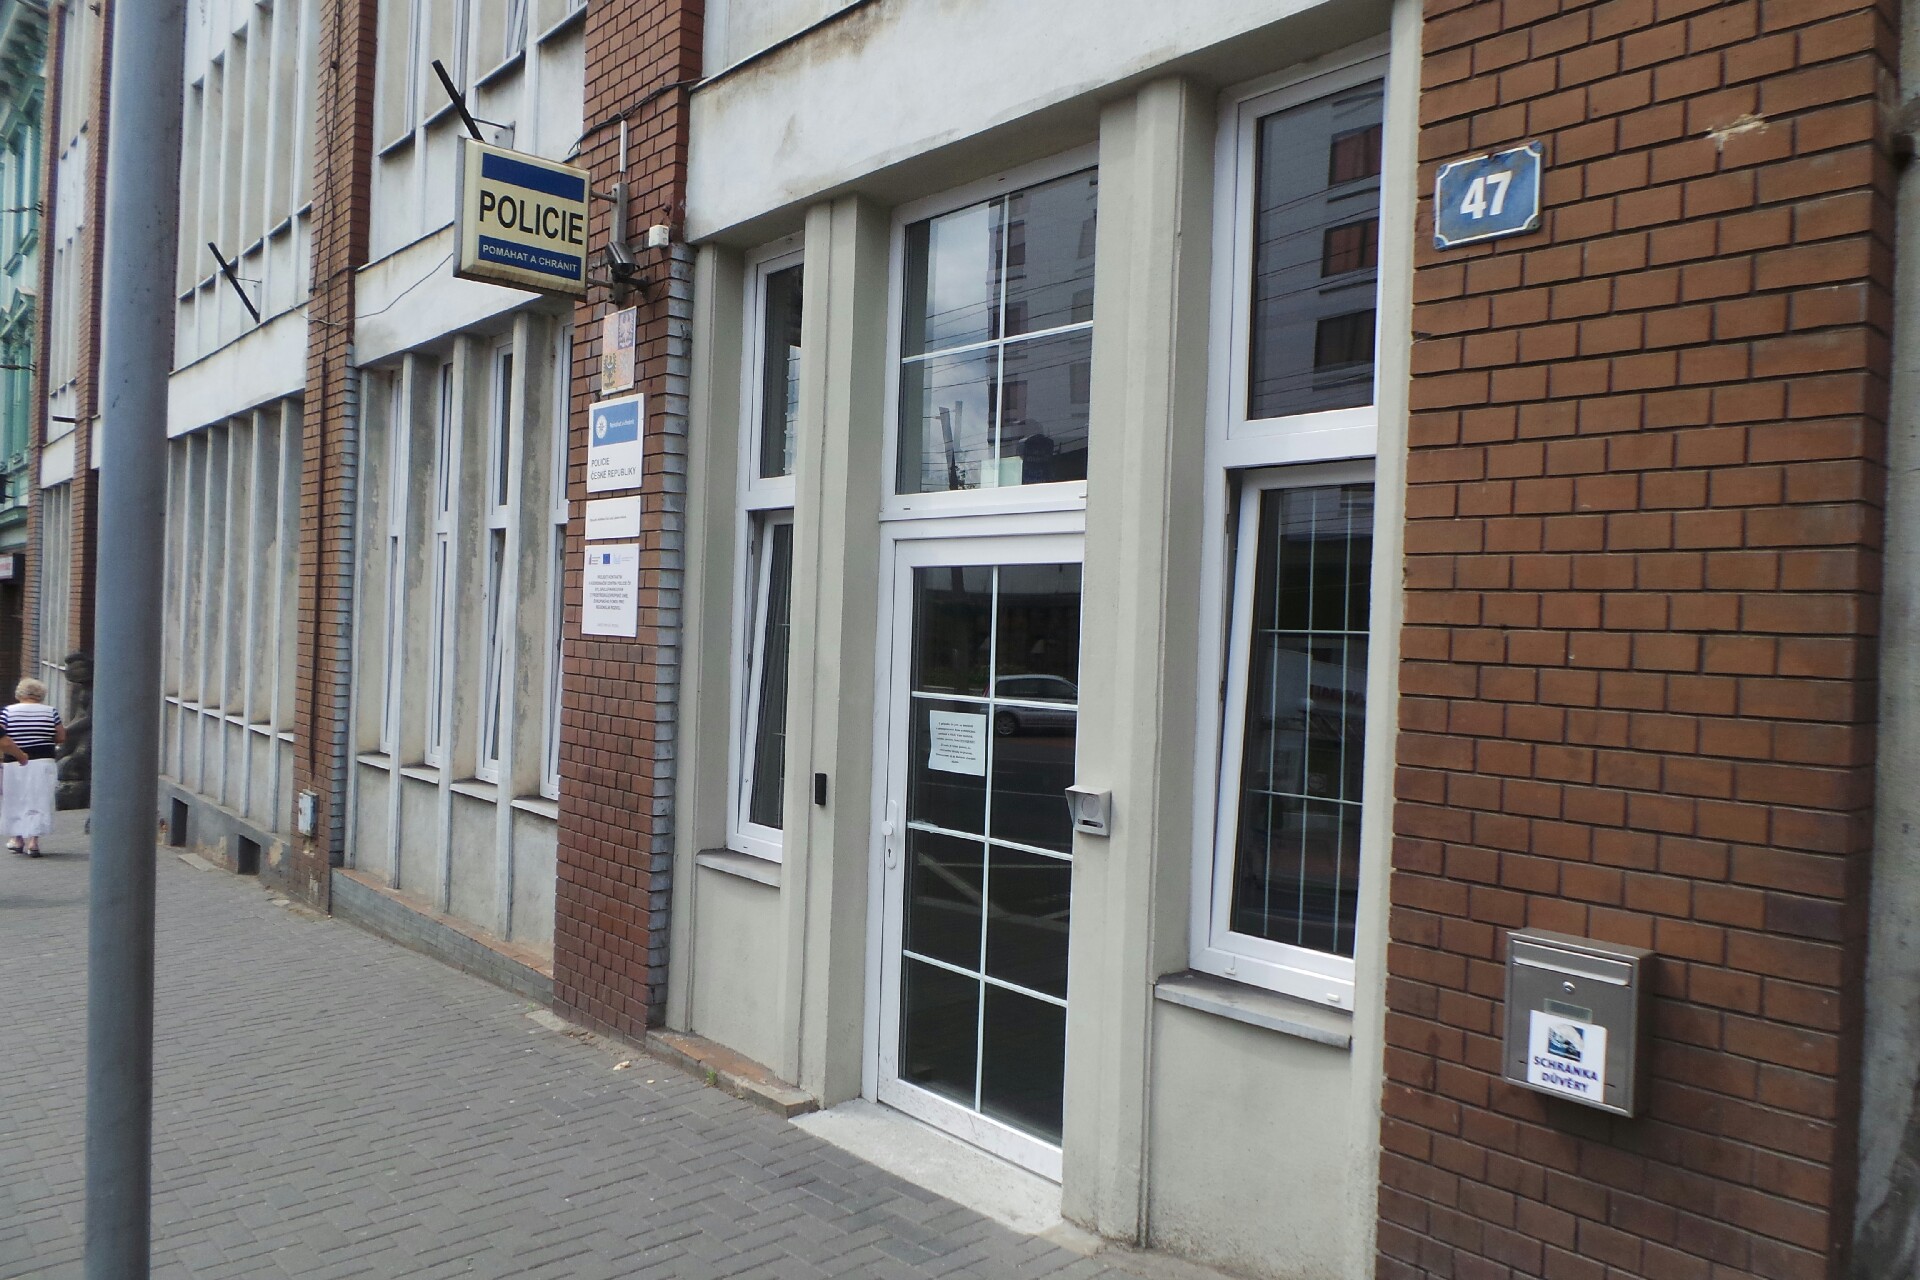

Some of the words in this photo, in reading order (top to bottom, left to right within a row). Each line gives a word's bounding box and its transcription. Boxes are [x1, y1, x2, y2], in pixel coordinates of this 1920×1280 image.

[1460, 170, 1513, 219] 47
[479, 190, 584, 245] POLICIE
[482, 244, 528, 262] POMÁHAT
[530, 255, 537, 264] A
[538, 256, 578, 272] CHRÁNIT
[591, 457, 610, 467] POLICIE
[607, 466, 637, 478] REPUBLIKY
